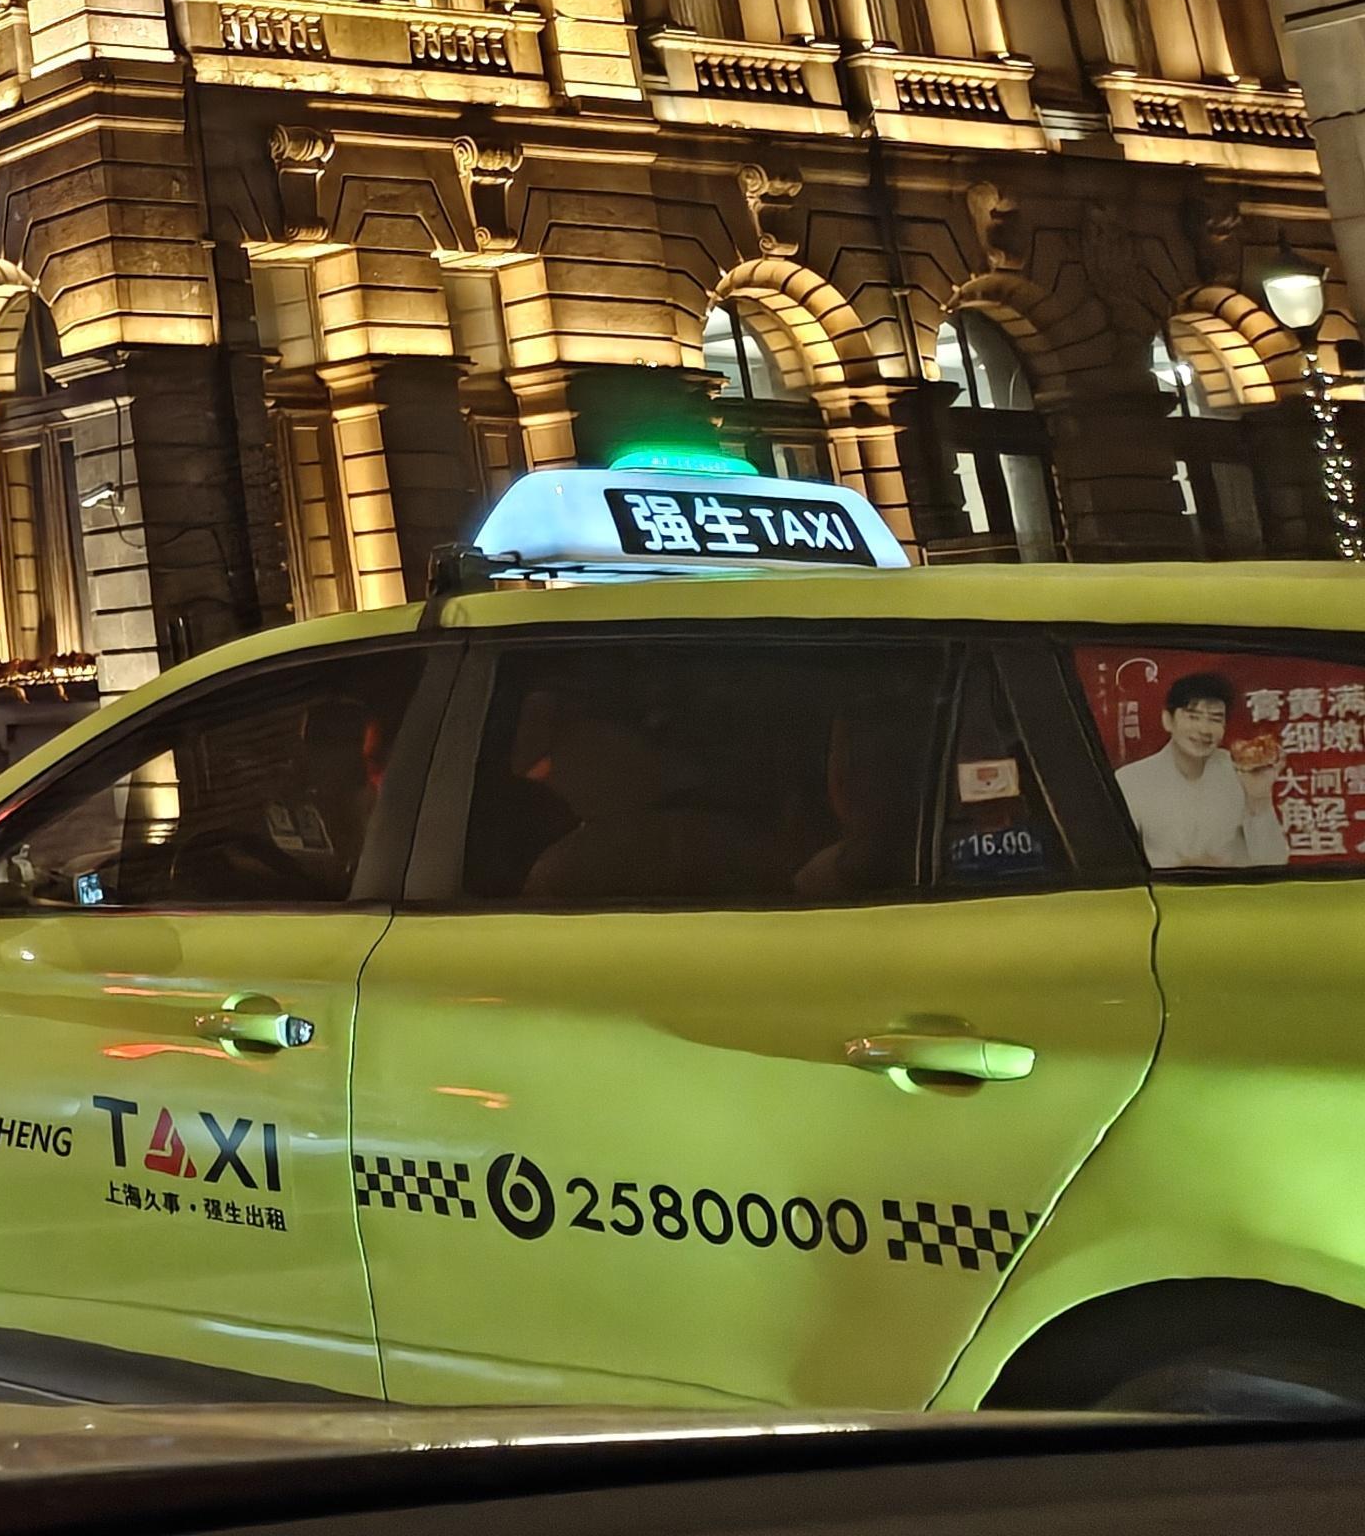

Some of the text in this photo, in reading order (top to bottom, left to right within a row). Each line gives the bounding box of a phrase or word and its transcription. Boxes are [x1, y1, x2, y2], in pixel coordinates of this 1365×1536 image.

[624, 494, 855, 553] 强生 TAXI
[93, 1095, 282, 1192] TAXI
